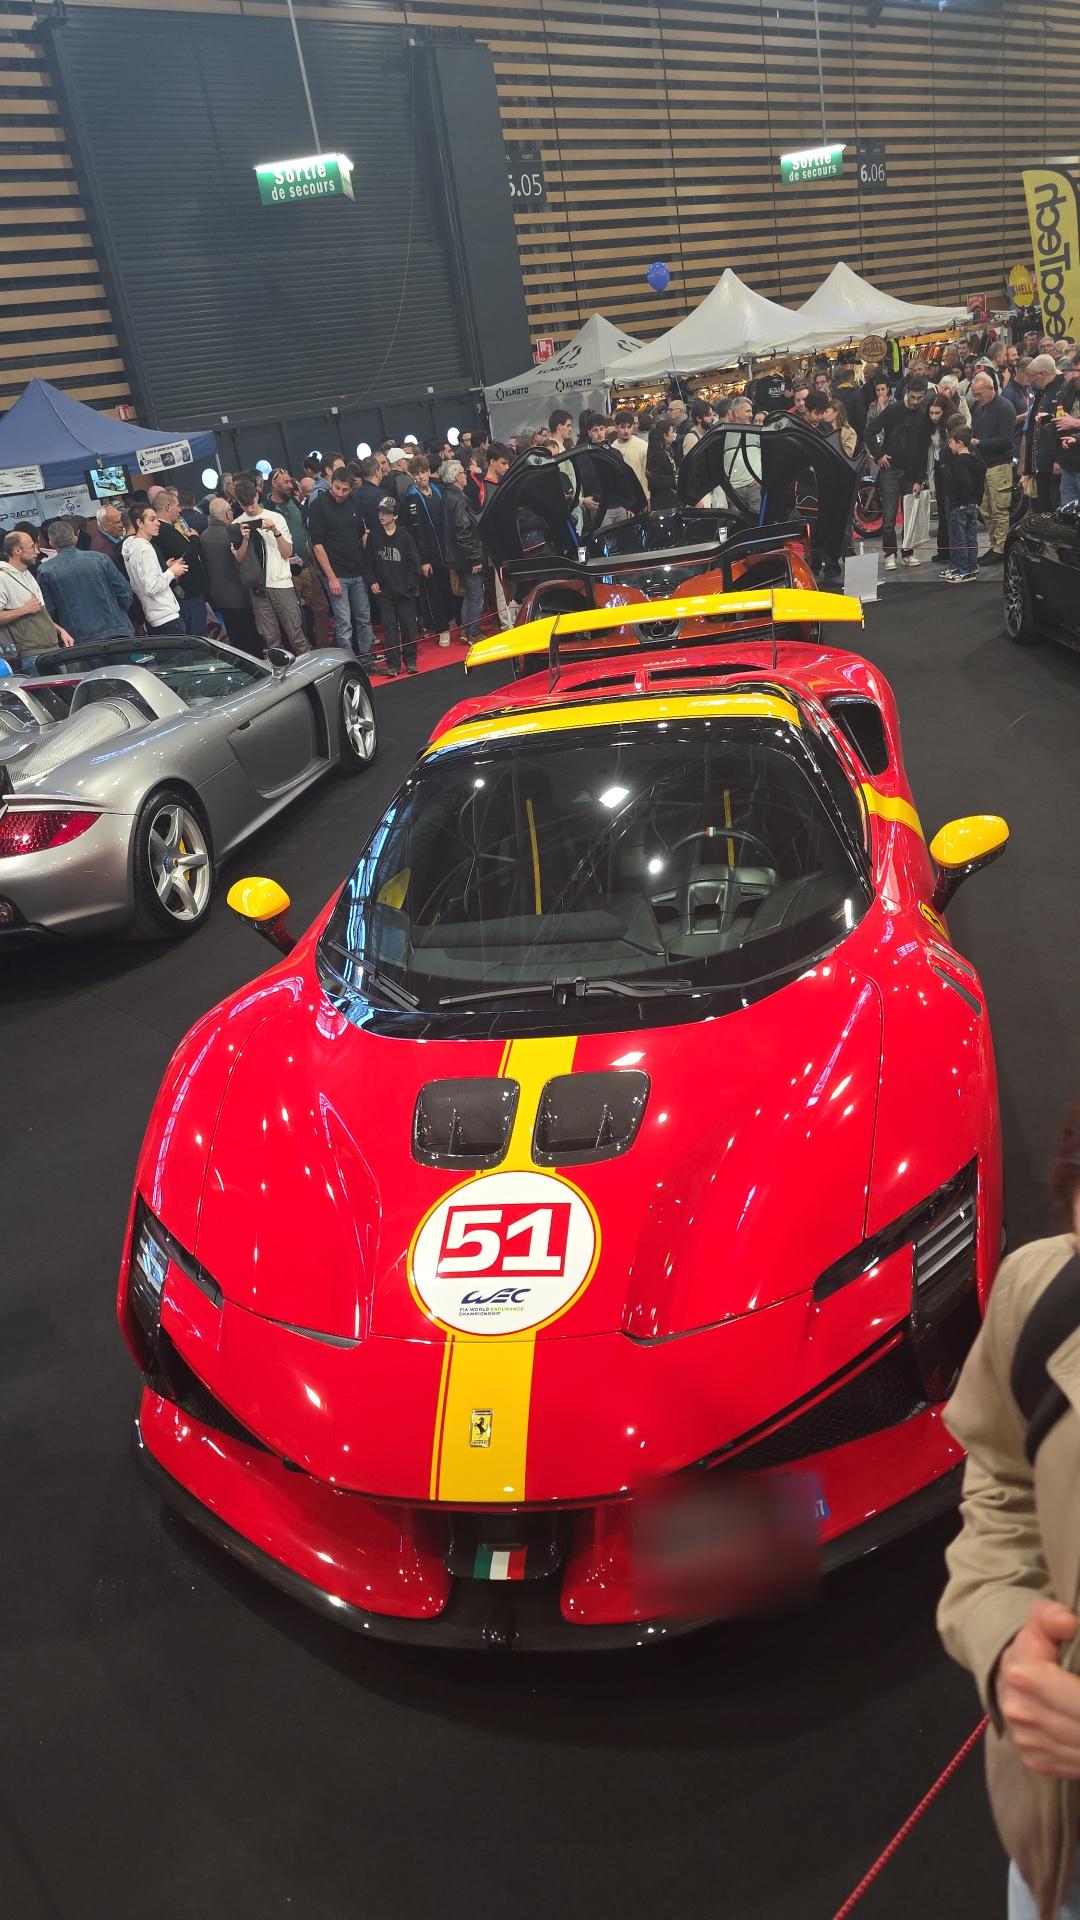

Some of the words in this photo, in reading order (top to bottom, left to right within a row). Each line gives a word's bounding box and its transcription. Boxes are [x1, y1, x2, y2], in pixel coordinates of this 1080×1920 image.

[273, 163, 327, 185] Sortie
[788, 170, 800, 182] de
[802, 164, 837, 179] secours
[860, 163, 885, 182] 6.06
[271, 186, 286, 201] de
[289, 179, 336, 198] secours
[505, 386, 529, 397] XLMOTO
[565, 378, 592, 389] XLMOTO
[436, 1208, 562, 1274] 51
[461, 1287, 532, 1304] WEC
